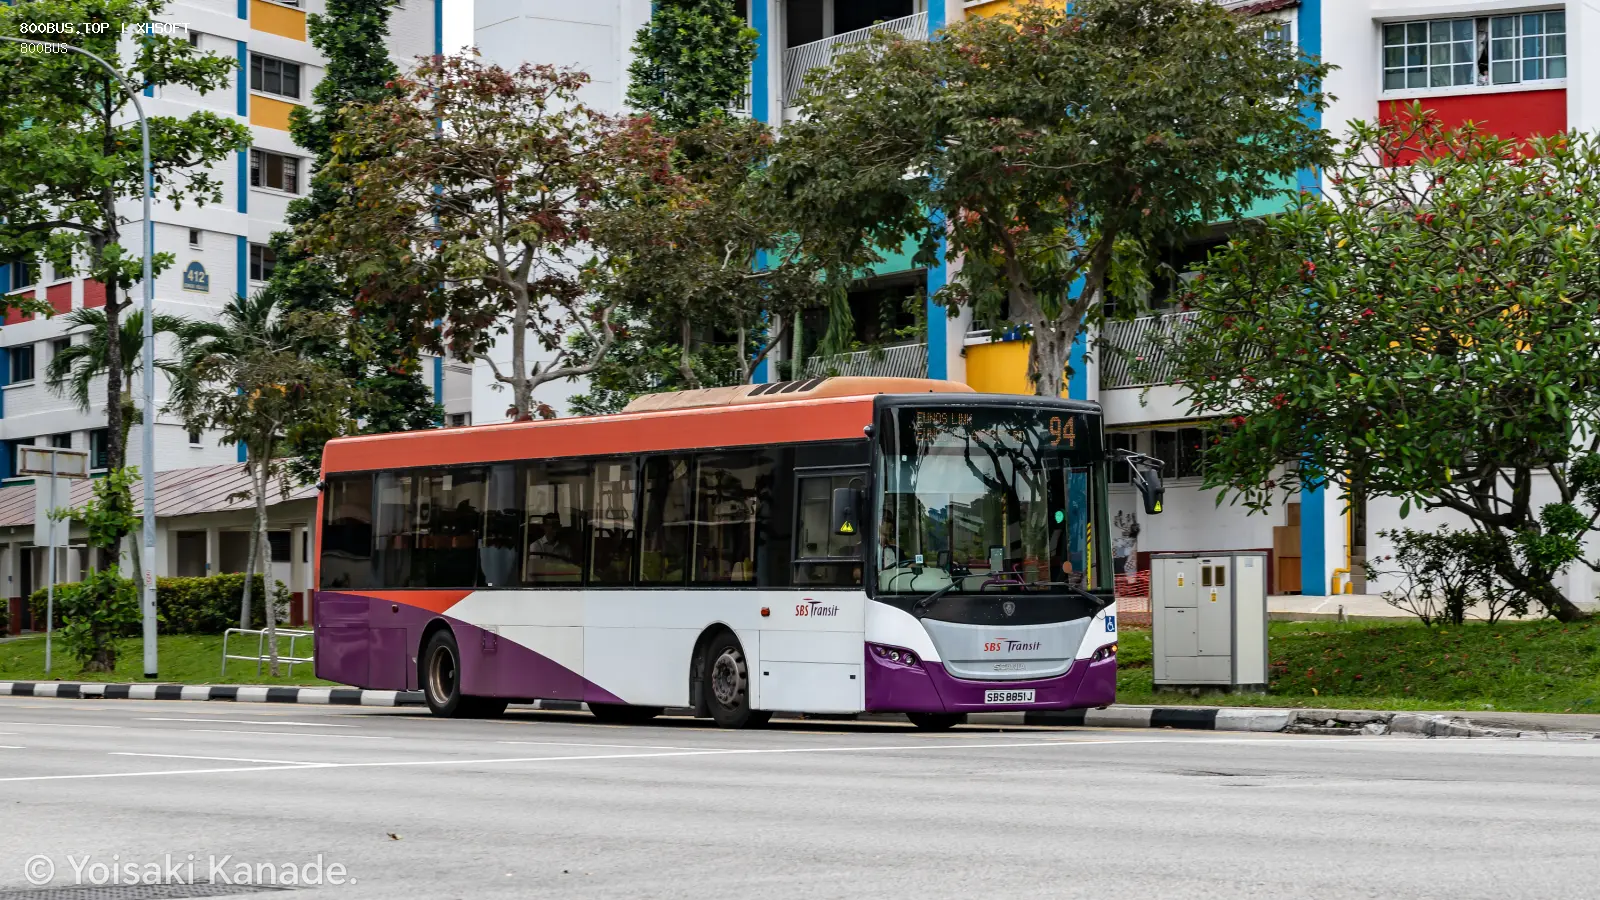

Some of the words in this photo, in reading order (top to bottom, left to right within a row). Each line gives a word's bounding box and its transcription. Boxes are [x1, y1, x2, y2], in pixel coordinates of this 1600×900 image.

[187, 269, 206, 283] 412
[916, 411, 948, 426] EUNOS
[951, 412, 973, 426] LINK
[1049, 416, 1076, 447] 94
[795, 604, 809, 617] SBS
[808, 600, 840, 618] Transit
[983, 642, 1001, 652] SBS
[1003, 640, 1042, 653] Transit
